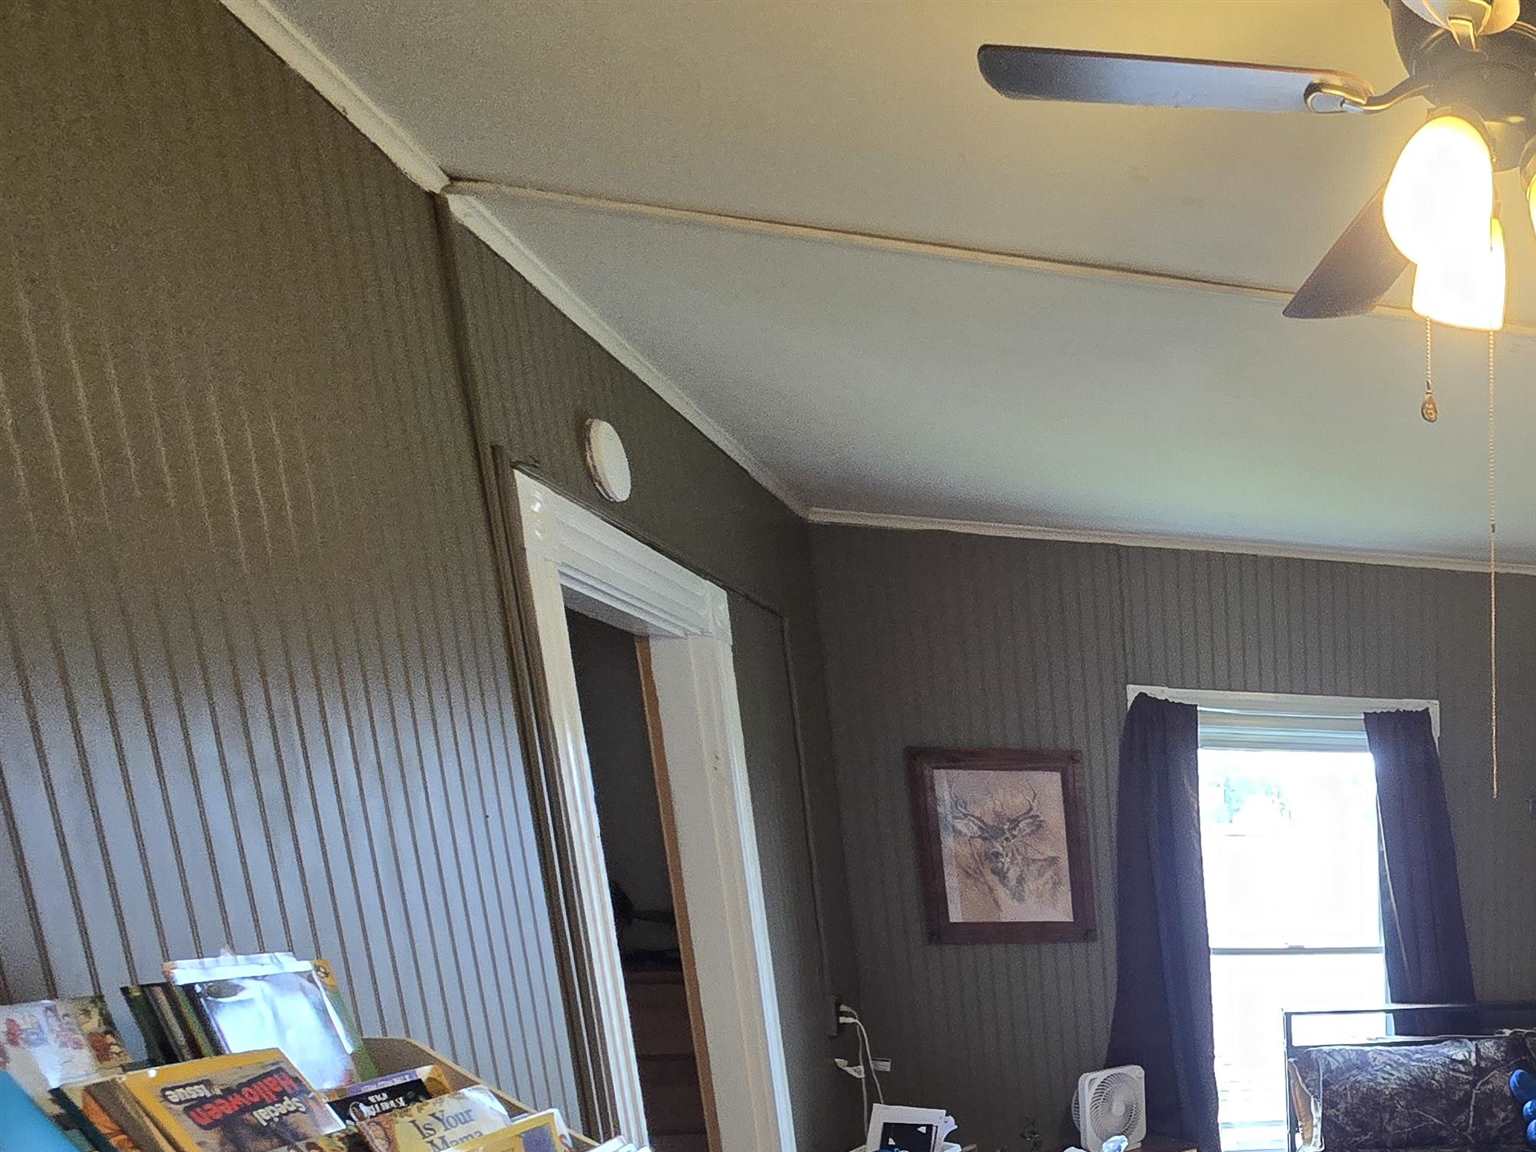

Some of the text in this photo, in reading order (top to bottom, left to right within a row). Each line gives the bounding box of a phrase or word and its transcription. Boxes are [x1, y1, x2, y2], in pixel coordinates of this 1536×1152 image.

[164, 1082, 211, 1104] Issue
[188, 1070, 300, 1126] Halloween
[252, 1096, 307, 1128] Special
[409, 1107, 474, 1140] Is Your
